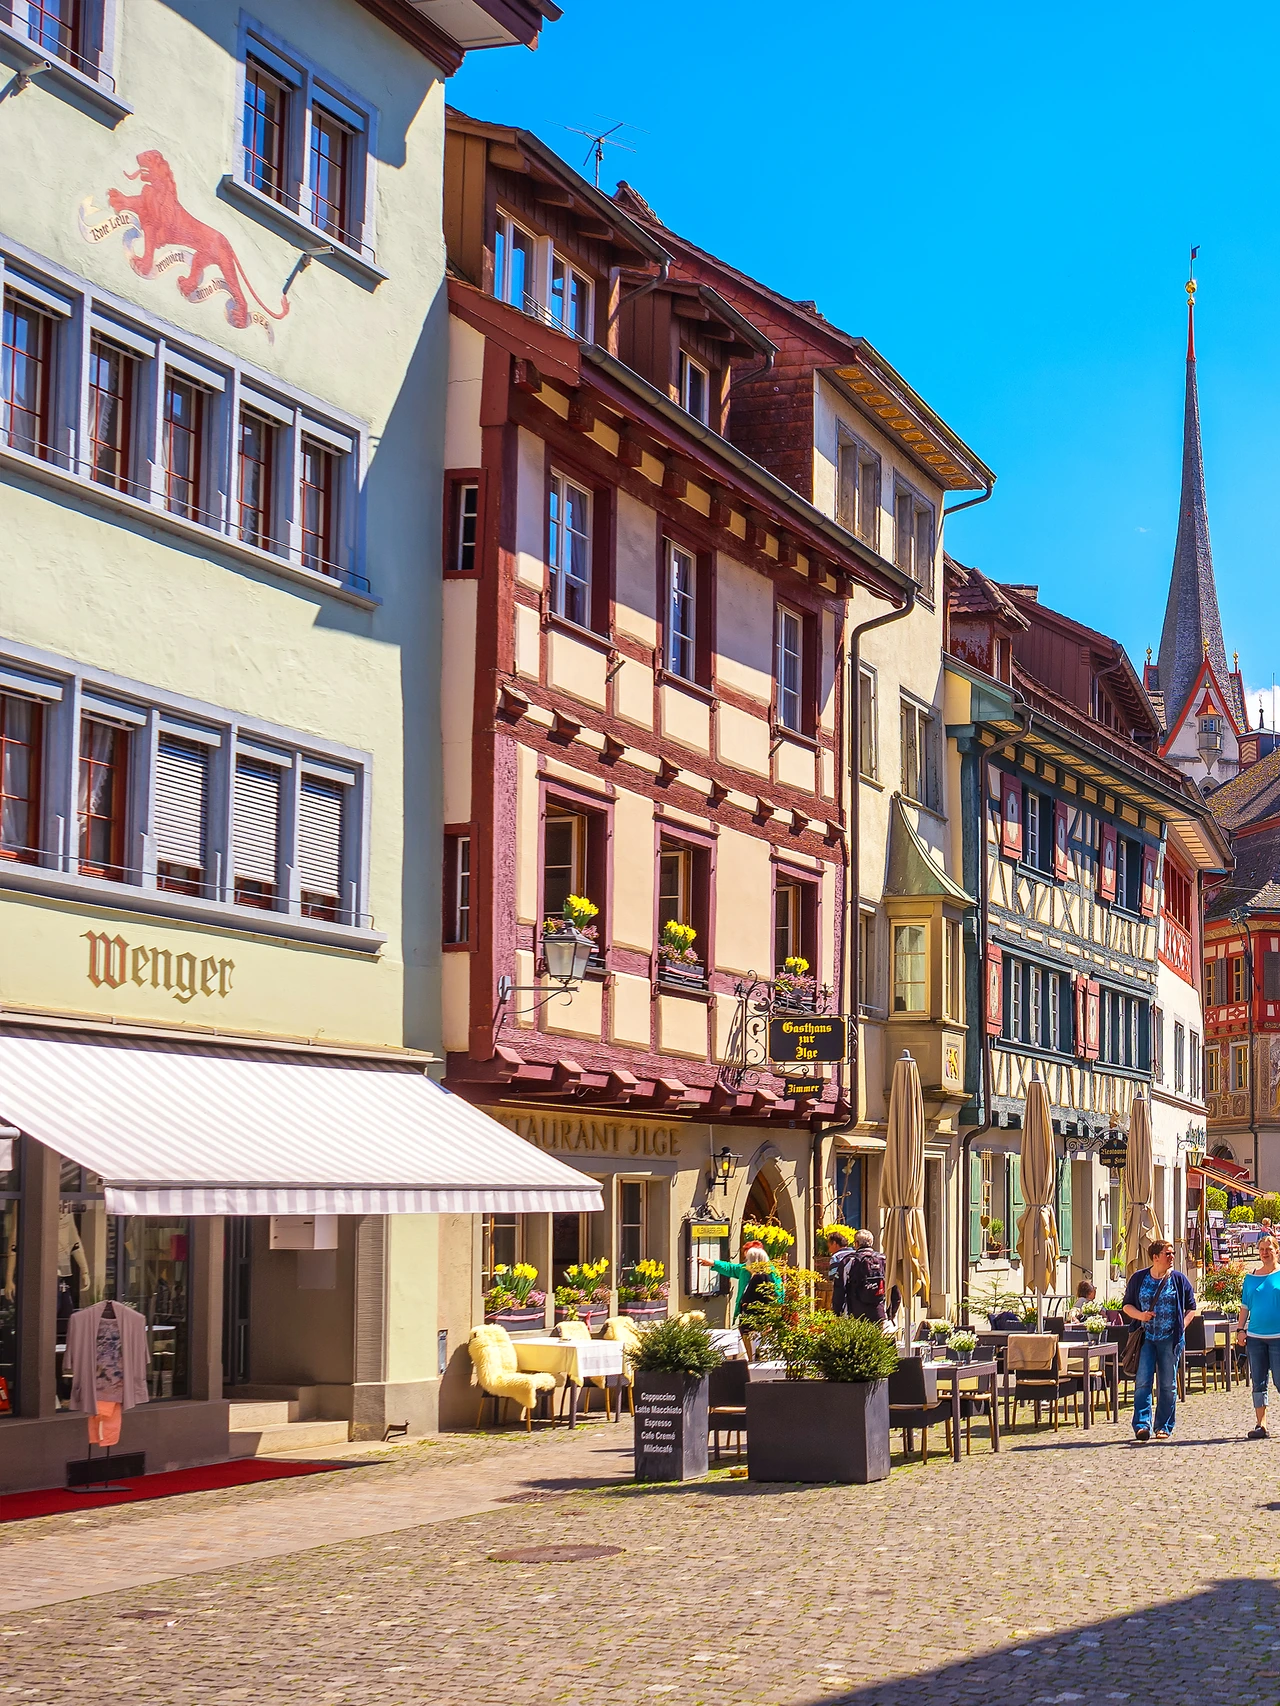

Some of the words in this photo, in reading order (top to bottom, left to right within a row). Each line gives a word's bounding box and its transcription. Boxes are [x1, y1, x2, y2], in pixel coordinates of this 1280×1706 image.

[79, 930, 236, 1004] Wenger
[798, 1035, 815, 1046] zur
[787, 1083, 820, 1096] Zimmer
[641, 1392, 676, 1402] Cappuccino
[635, 1404, 651, 1414] Latte
[651, 1405, 683, 1414] Macchiato
[644, 1418, 672, 1428] Espresso
